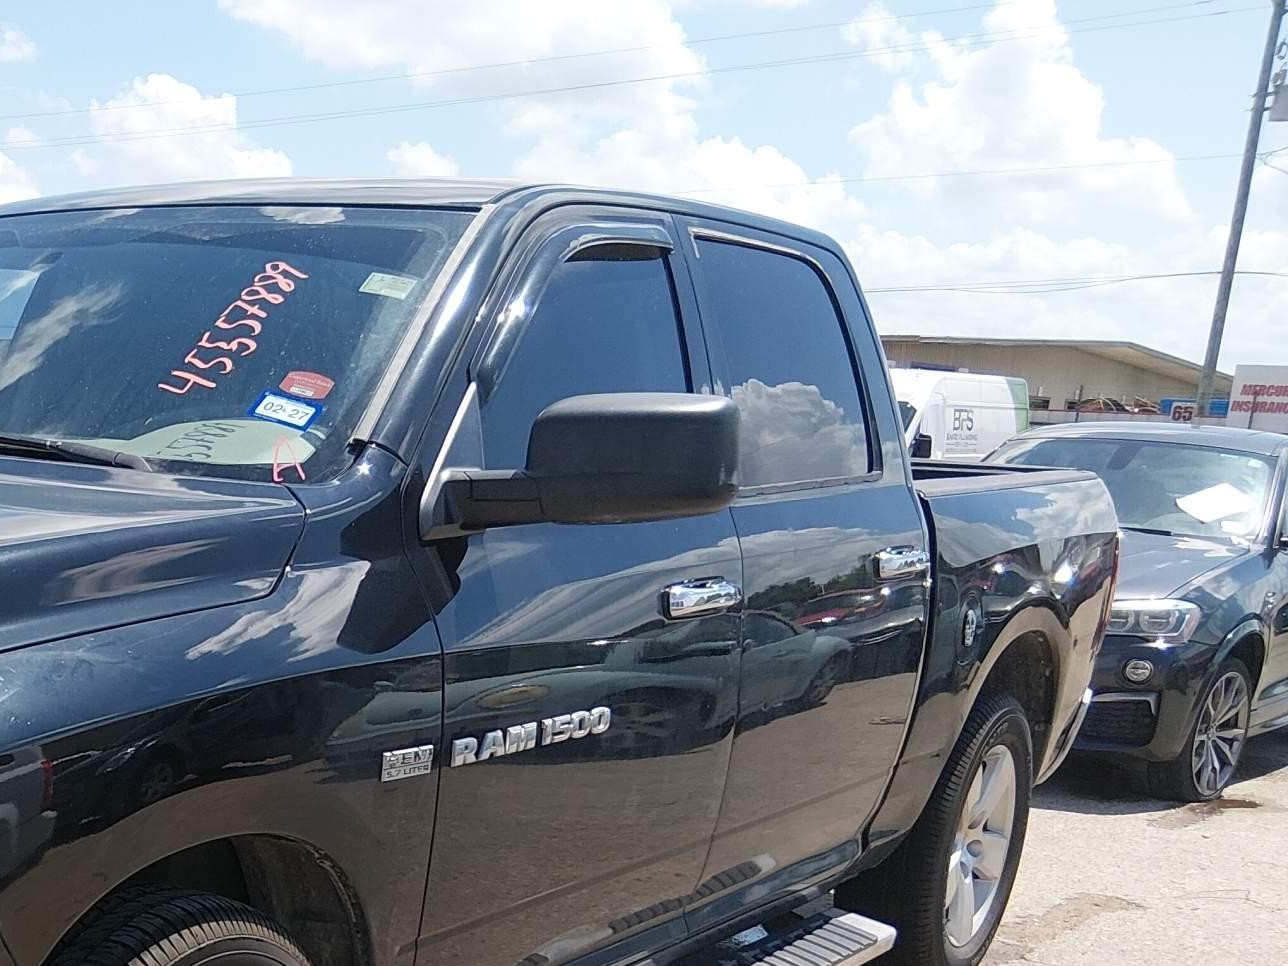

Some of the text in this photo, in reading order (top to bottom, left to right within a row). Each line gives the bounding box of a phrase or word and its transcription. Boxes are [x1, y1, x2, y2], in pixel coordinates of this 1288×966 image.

[158, 261, 309, 395] 45557889
[288, 408, 310, 421] 27
[1172, 405, 1193, 421] 65
[272, 435, 306, 482] A
[451, 706, 611, 768] RAM 1500
